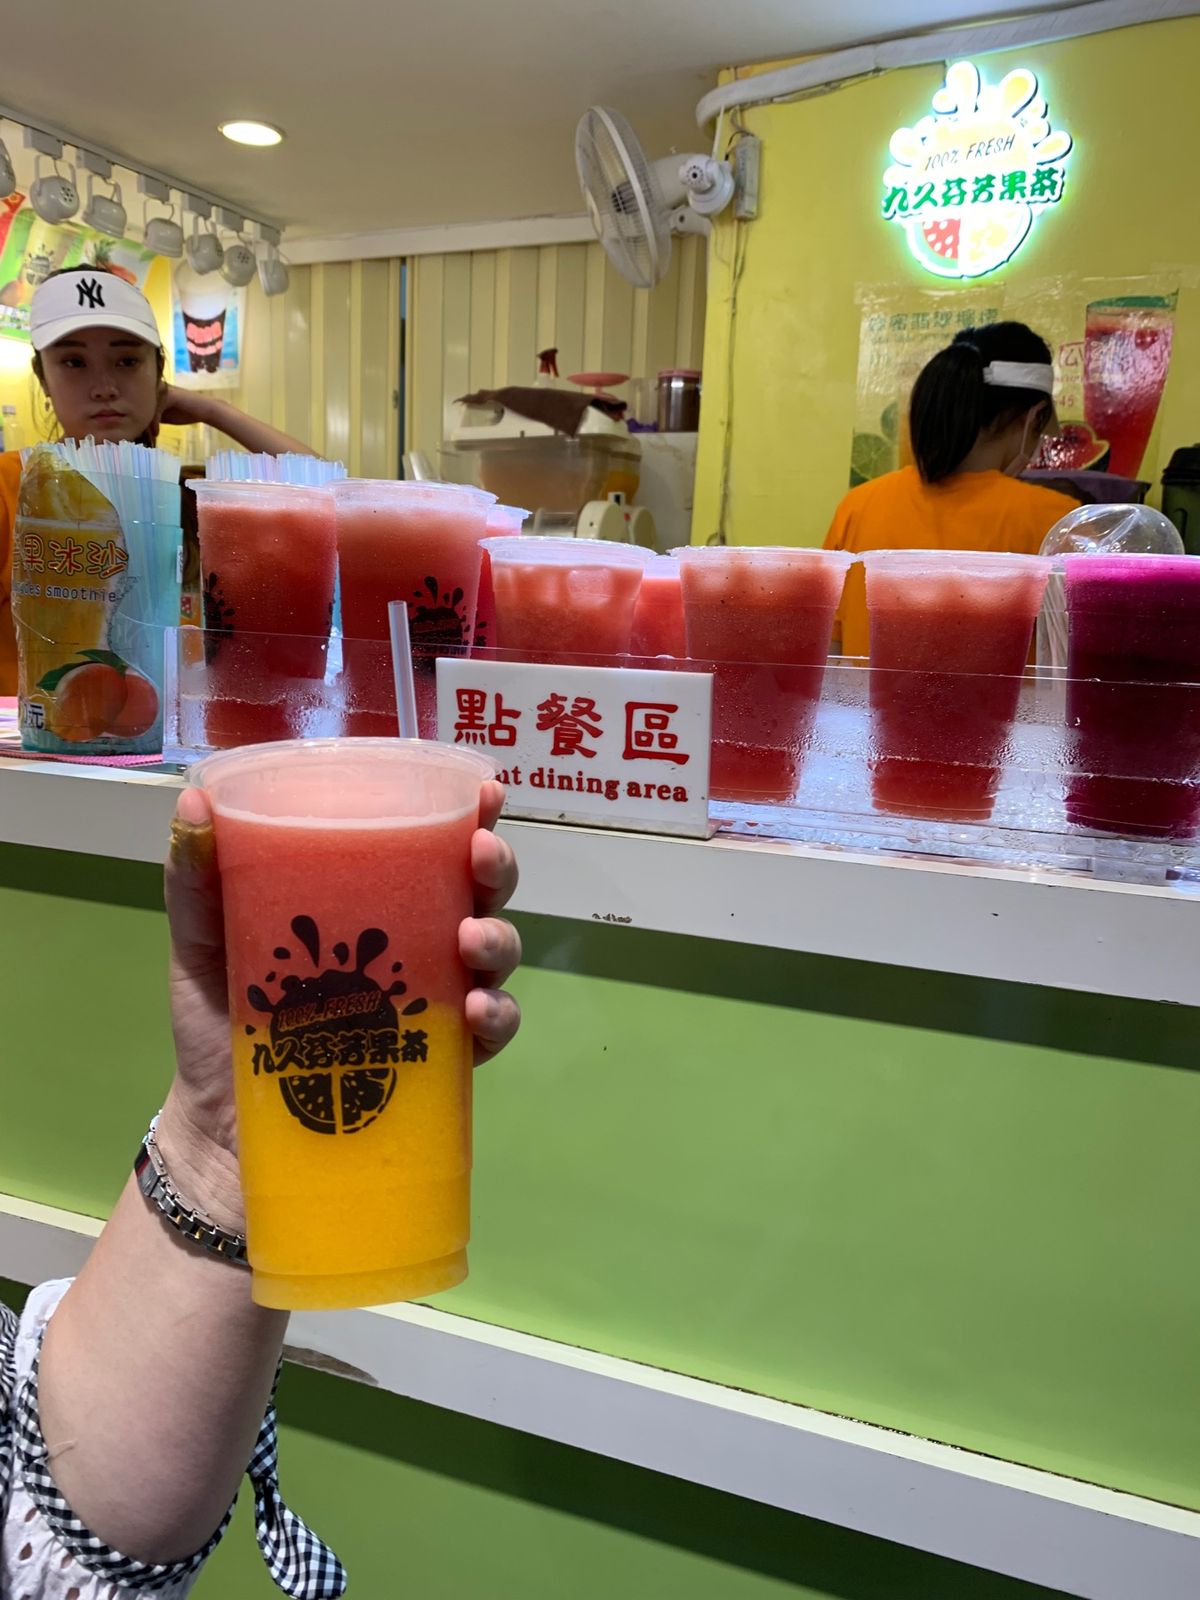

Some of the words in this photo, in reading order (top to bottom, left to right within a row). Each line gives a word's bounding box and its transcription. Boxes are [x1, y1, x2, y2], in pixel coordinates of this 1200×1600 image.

[924, 148, 960, 172] 100%
[965, 133, 1017, 162] FRESH
[454, 688, 690, 766] 點餐區
[529, 766, 620, 801] dining
[626, 780, 689, 803] area
[323, 990, 382, 1019] FRESH
